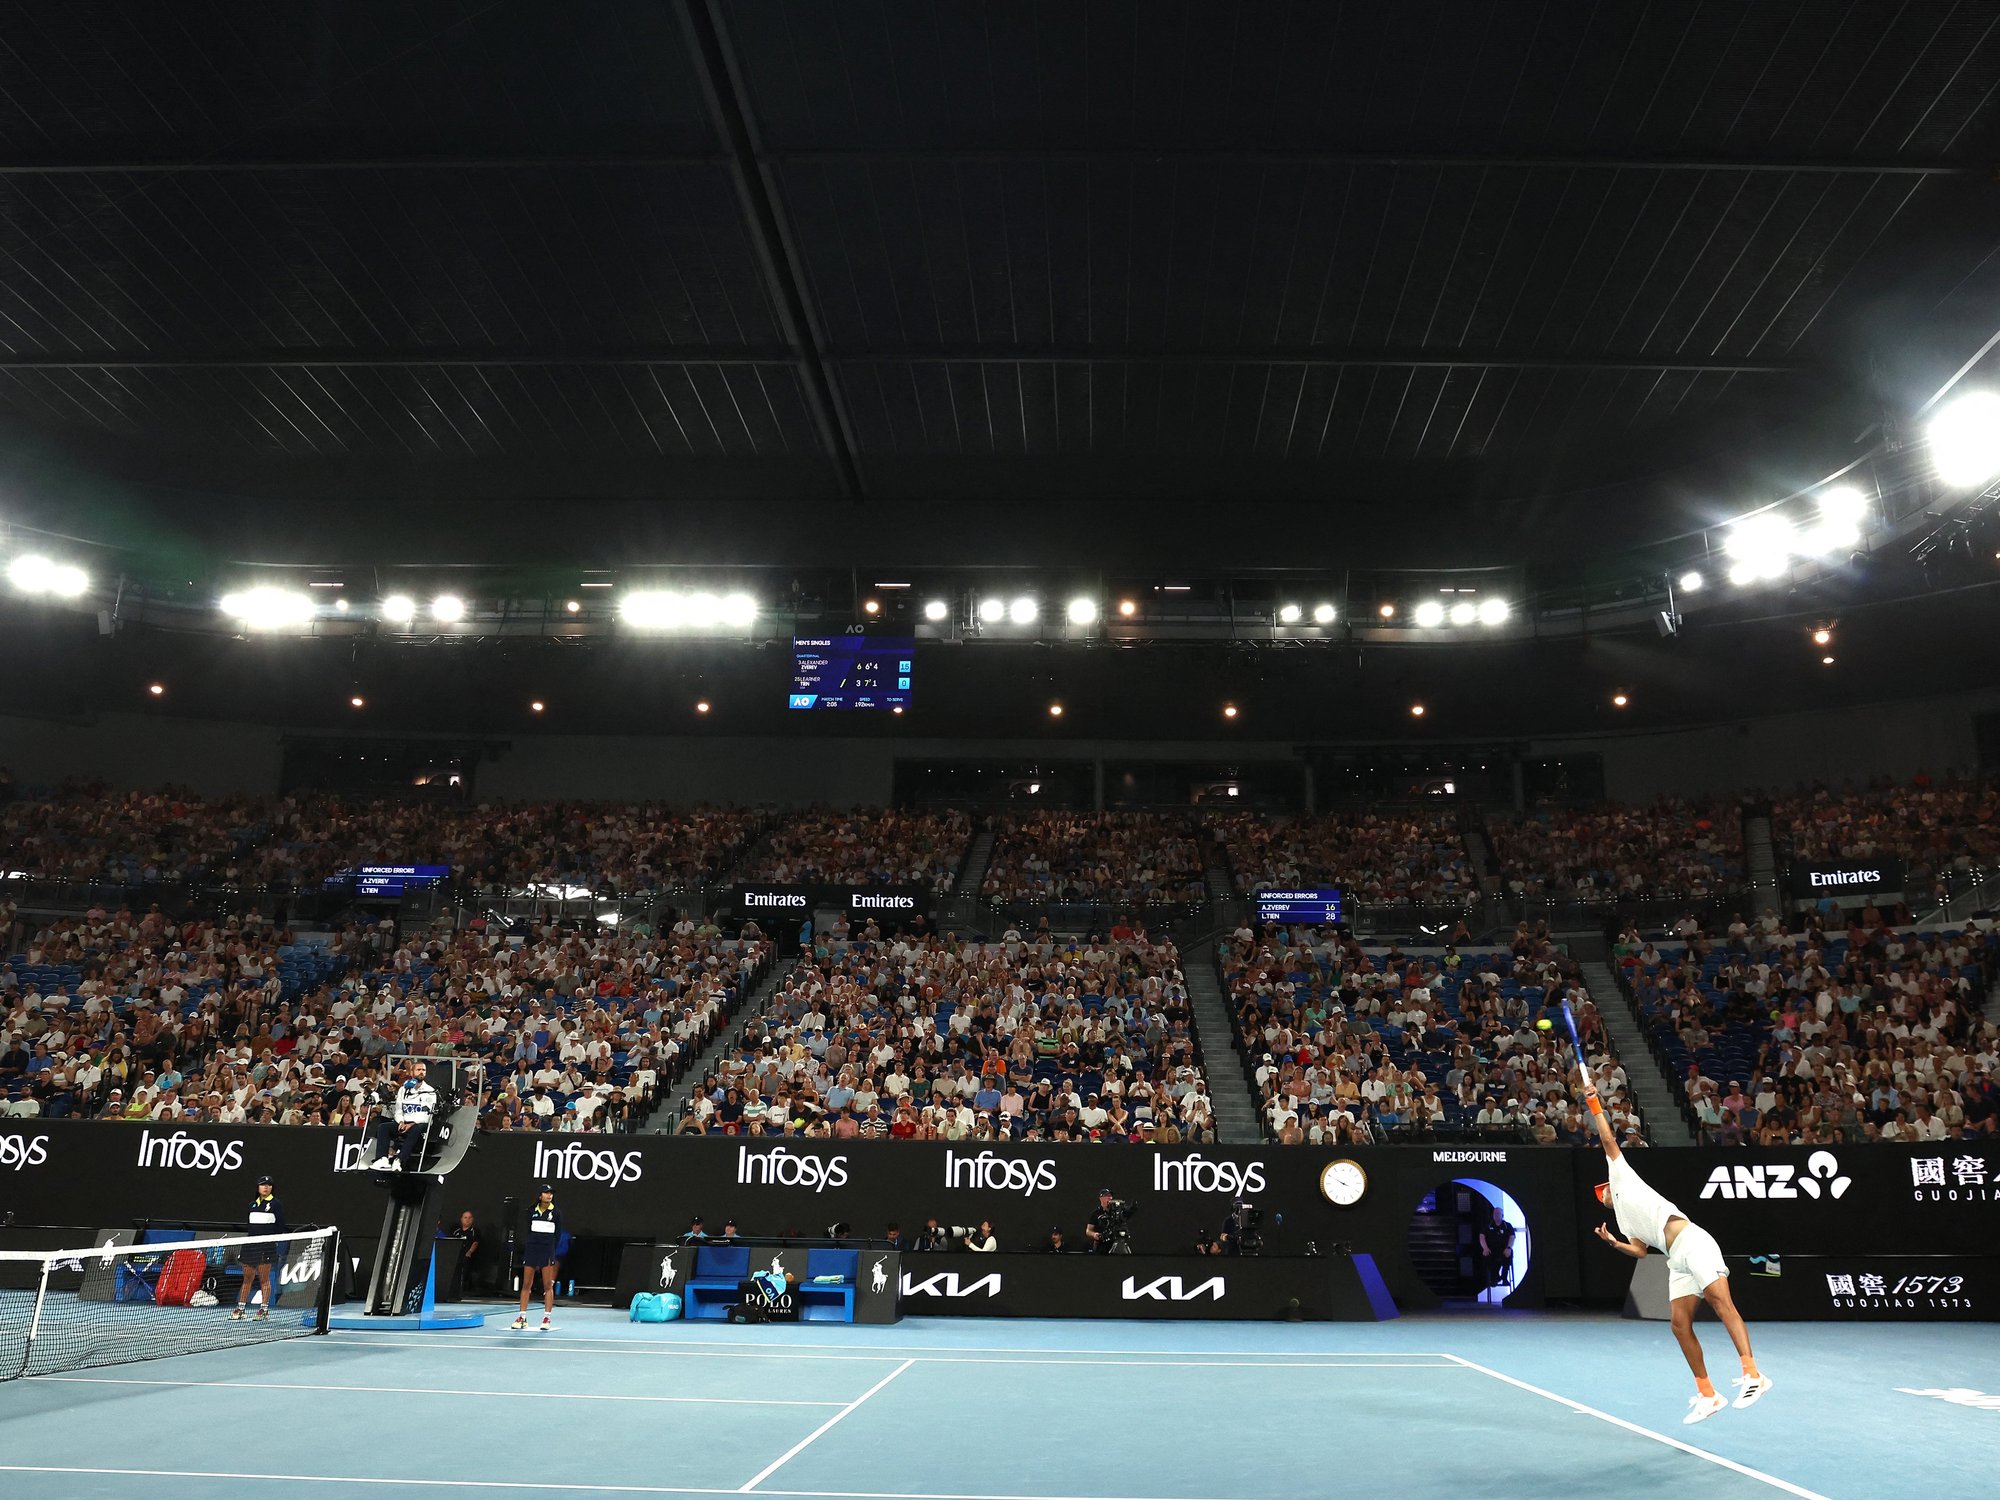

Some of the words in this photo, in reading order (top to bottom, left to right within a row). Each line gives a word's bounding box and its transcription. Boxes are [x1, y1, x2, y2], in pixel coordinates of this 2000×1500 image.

[1809, 869, 1881, 887] Emirates
[744, 892, 807, 907] Emirates
[851, 893, 914, 908] Emirates
[1325, 912, 1336, 920] 28
[137, 1130, 244, 1176] Infosys
[533, 1140, 642, 1189] Infosys
[1432, 1151, 1507, 1163] MELBOURNE
[737, 1145, 848, 1193] Infosys
[945, 1149, 1057, 1197] Infosys
[1154, 1152, 1266, 1197] Infosys
[1699, 1164, 1798, 1199] ANZ
[902, 1271, 1002, 1298] KIA
[1121, 1275, 1226, 1301] KIA
[1833, 1298, 1915, 1308] GUOJIAO
[1929, 1298, 1972, 1308] 1573
